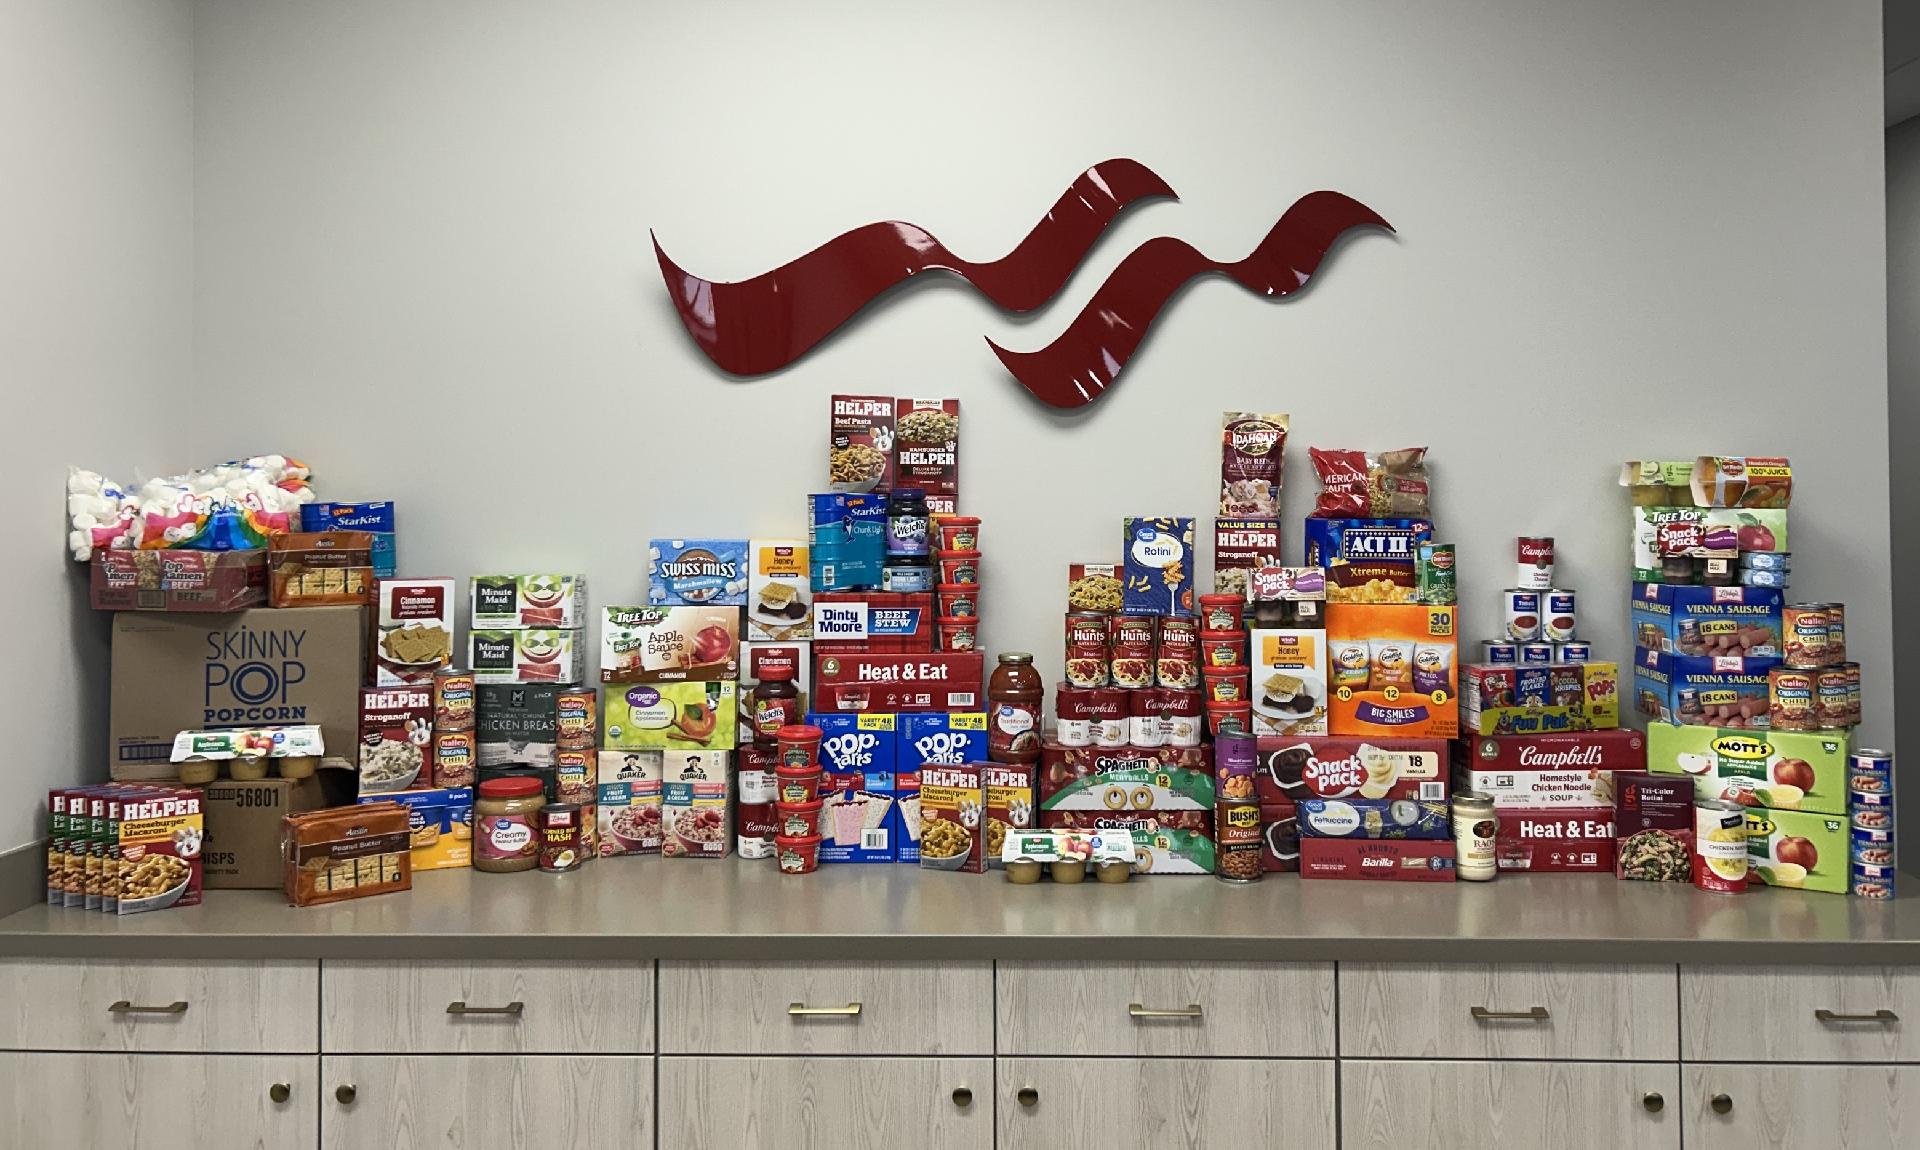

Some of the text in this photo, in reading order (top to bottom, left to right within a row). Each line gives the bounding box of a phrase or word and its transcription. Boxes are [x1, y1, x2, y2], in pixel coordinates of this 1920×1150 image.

[834, 401, 891, 416] HELPER
[852, 418, 872, 426] Pasta
[1232, 432, 1278, 448] IDAHOAN
[900, 451, 955, 465] HELPER
[1325, 473, 1366, 484] MERICAN
[852, 504, 887, 517] StarKist
[1652, 510, 1700, 521] TREE TOP
[338, 515, 380, 525] StarKist
[896, 520, 926, 537] Welch's
[1412, 524, 1422, 532] 12
[1660, 527, 1699, 542] Snack
[1218, 533, 1277, 548] HELPER
[1351, 537, 1408, 552] ACT II
[1669, 537, 1698, 549] pack
[1145, 546, 1171, 556] Rotini
[1218, 551, 1258, 559] Stroganoff
[661, 562, 736, 578] SWISS MISS
[1351, 567, 1386, 576] Xtreme
[1255, 569, 1290, 583] Snack
[673, 578, 722, 590] Marshmallow
[1263, 580, 1290, 592] pack
[177, 592, 201, 600] BEEF
[481, 588, 512, 597] Minute
[400, 596, 436, 605] Cinnamon
[485, 596, 508, 604] Maid
[1686, 605, 1770, 614] VIENNA SAUSAGE
[617, 610, 662, 622] TREE TOP
[822, 609, 859, 622] Dinty
[875, 611, 910, 619] BEEF
[1431, 613, 1450, 625] 30
[875, 619, 912, 628] STEW
[1801, 617, 1825, 625] Nalley
[818, 621, 863, 633] Moore
[1702, 622, 1737, 632] 18 CANS
[647, 631, 684, 646] Apple
[479, 643, 509, 652] Minute
[647, 643, 683, 656] Sauce
[482, 650, 505, 659] Maid
[1342, 653, 1363, 662] Goldfish
[1381, 652, 1402, 661] Goldfish
[1418, 655, 1441, 663] Goldfish
[759, 657, 792, 665] Cinnamon
[827, 660, 835, 669] 6
[604, 671, 611, 679] 12
[859, 663, 948, 681] Heat & Eat
[205, 661, 306, 706] POP
[1686, 675, 1724, 683] VIENNA
[1780, 679, 1808, 688] Nalley
[446, 682, 471, 690] Nalley
[1555, 684, 1582, 693] KRISPIES
[1587, 681, 1616, 700] POPS
[443, 691, 471, 699] ORIGINAL
[629, 692, 658, 702] Organic
[1339, 689, 1350, 698] 10
[1386, 689, 1397, 698] 12
[1436, 693, 1442, 701] 8
[1702, 691, 1737, 702] 18 CANS
[1777, 689, 1810, 697] ORIGINAL
[365, 692, 429, 710] HELPER
[1145, 699, 1188, 711] Campbell's
[1074, 702, 1117, 714] Campbell's
[204, 706, 307, 723] POPCORN
[365, 712, 411, 721] Stroganoff
[758, 708, 784, 722] Welch's
[1371, 708, 1415, 719] BIG SMILES
[480, 720, 556, 731] HICKEN BREAS
[1512, 713, 1569, 730] Fun Pak
[441, 739, 467, 747] Nalley
[1485, 744, 1493, 752] 6
[1824, 742, 1836, 751] 36
[1408, 755, 1423, 767] 18
[1519, 745, 1601, 769] Campbell's
[1306, 756, 1361, 778] Snack
[617, 771, 646, 780] QUAKER
[680, 773, 708, 781] QUAKER
[922, 769, 978, 788] HELPER
[1157, 776, 1168, 784] 12
[1540, 774, 1582, 783] Homestyle
[1319, 772, 1361, 792] pack
[1532, 783, 1592, 791] Chicken Noodle
[922, 787, 968, 798] Cheeseburger
[1641, 787, 1674, 795] Tri-Color
[236, 789, 279, 808] 56801
[922, 793, 954, 801] Macaroni
[124, 799, 199, 821] HELPER
[1230, 811, 1259, 822] BUSH'S
[1314, 816, 1353, 825] Fettuccine
[124, 818, 186, 831] Cheeseburger
[1520, 820, 1614, 838] Heat & Eat
[1827, 822, 1839, 830] 36
[124, 827, 168, 837] Macaroni
[495, 830, 527, 841] Creamy
[1229, 829, 1260, 839] Original
[548, 833, 571, 842] HASH
[1157, 838, 1168, 846] 12
[332, 839, 382, 851] Peanut Butter
[1709, 843, 1734, 851] CHICKEN
[1361, 857, 1394, 867] Barilla
